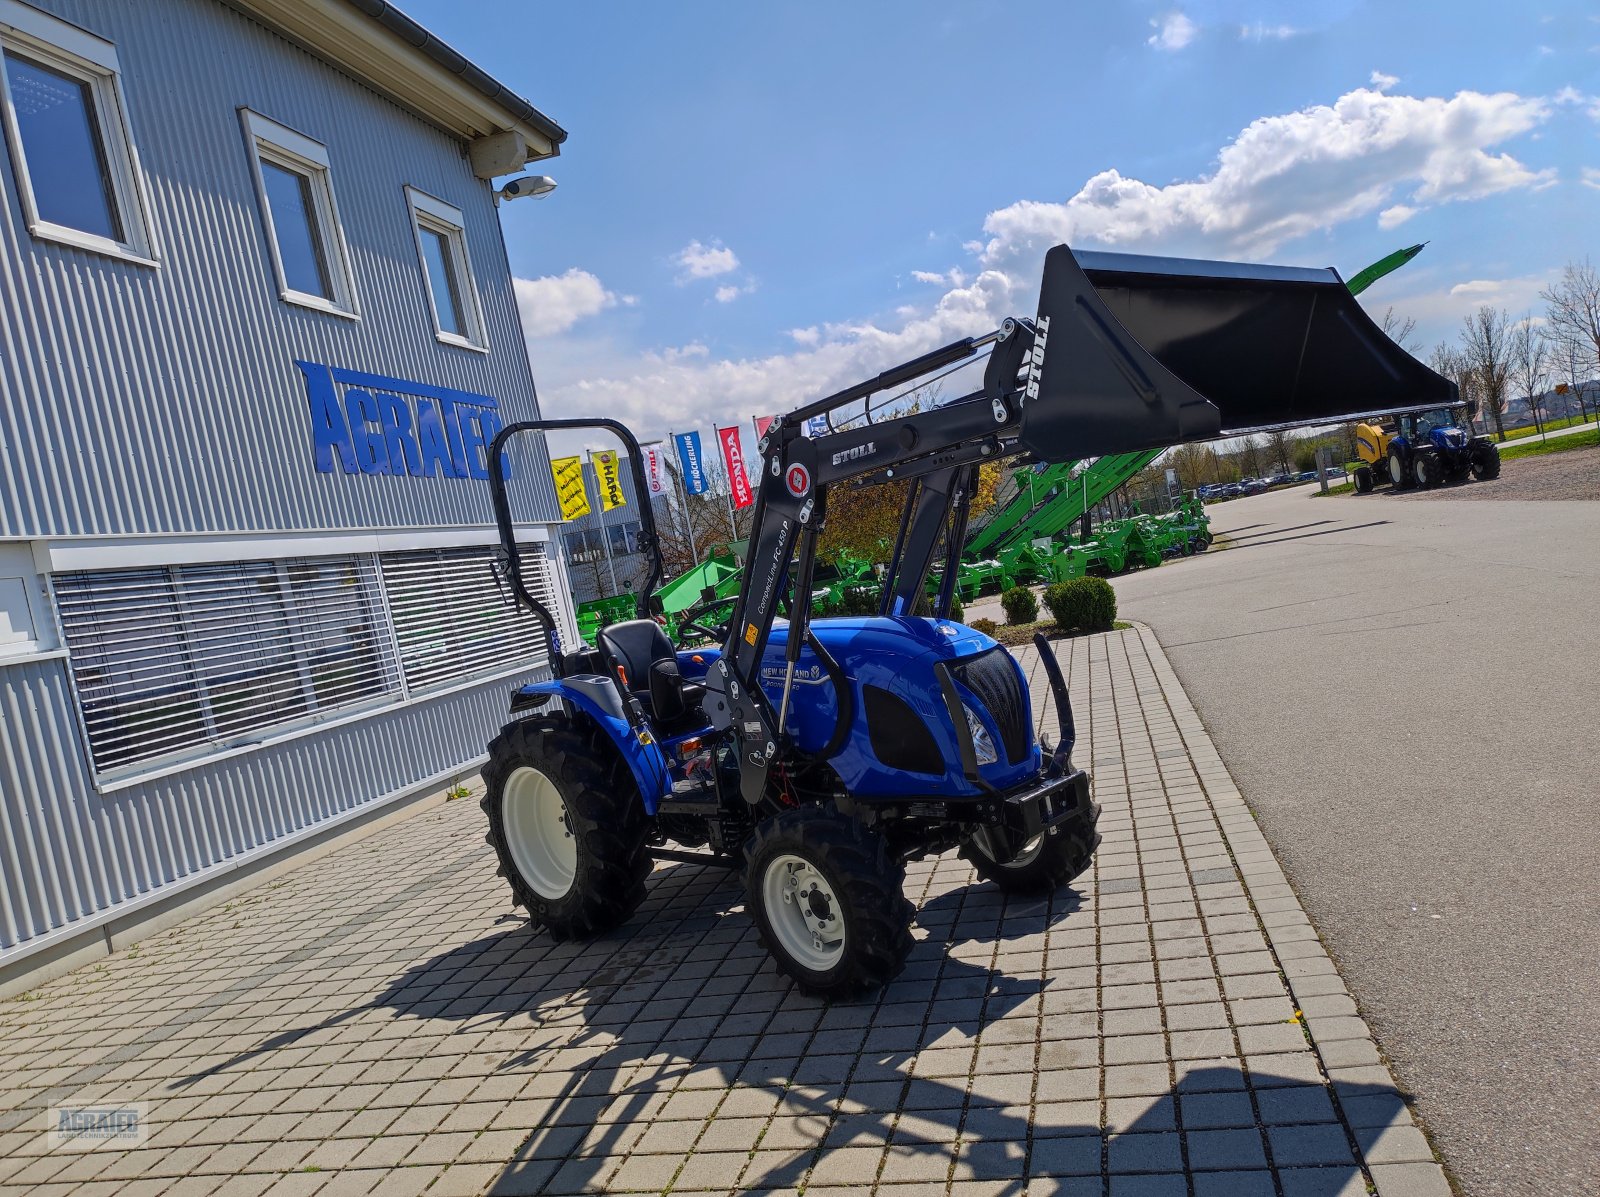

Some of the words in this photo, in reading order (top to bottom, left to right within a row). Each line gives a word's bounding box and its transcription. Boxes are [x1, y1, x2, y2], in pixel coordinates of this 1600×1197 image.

[1026, 315, 1051, 400] STOLL
[295, 360, 511, 481] AGRATEC
[684, 435, 701, 479] KÖCKERLING
[727, 431, 748, 504] HONDA
[832, 441, 877, 466] STOLL
[777, 529, 787, 548] 450
[782, 520, 789, 530] P
[773, 546, 782, 562] FC
[757, 562, 778, 615] CompactLine
[763, 667, 778, 676] NEW
